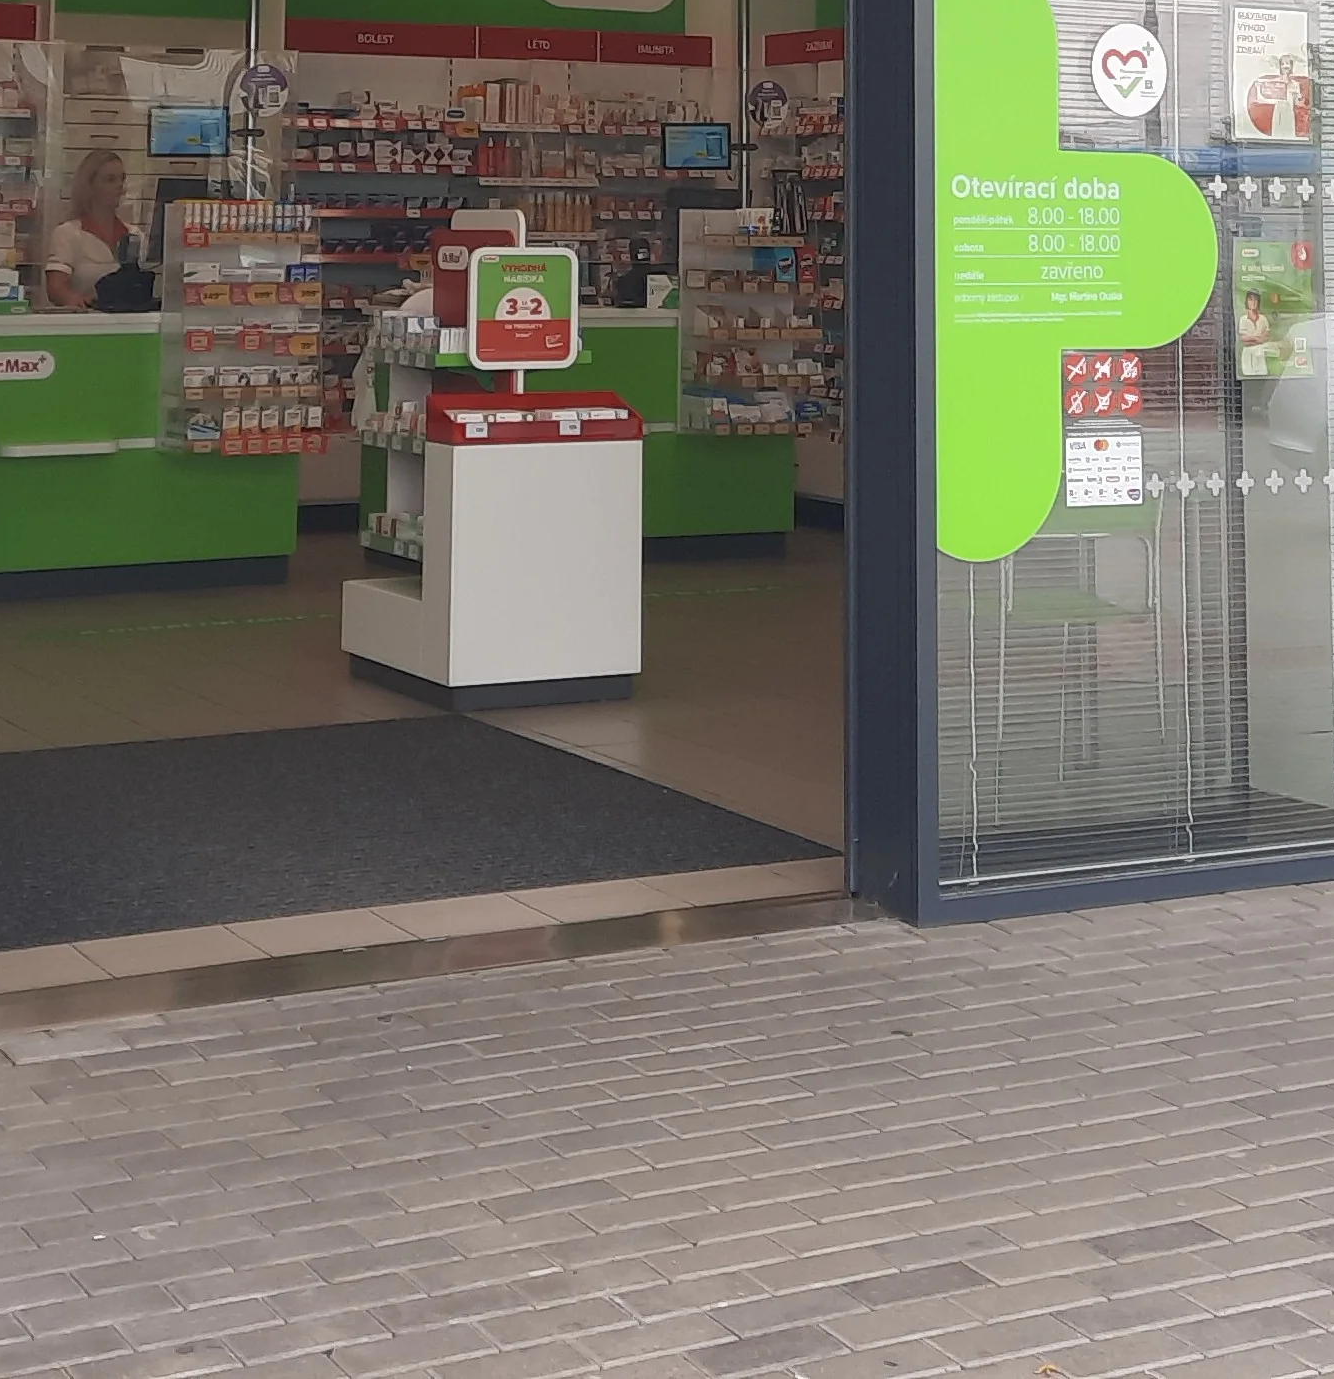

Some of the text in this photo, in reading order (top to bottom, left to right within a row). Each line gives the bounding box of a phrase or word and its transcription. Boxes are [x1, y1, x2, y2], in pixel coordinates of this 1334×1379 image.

[527, 37, 551, 50] LÉTO
[951, 174, 1120, 200] Otevírací doba
[1027, 207, 1064, 225] 8.00
[1078, 207, 1120, 225] 18.00
[1028, 234, 1065, 252] 8.00
[1079, 234, 1120, 252] 18.00
[1041, 261, 1103, 280] zavřeno
[505, 297, 518, 315] 3
[529, 297, 542, 315] 2
